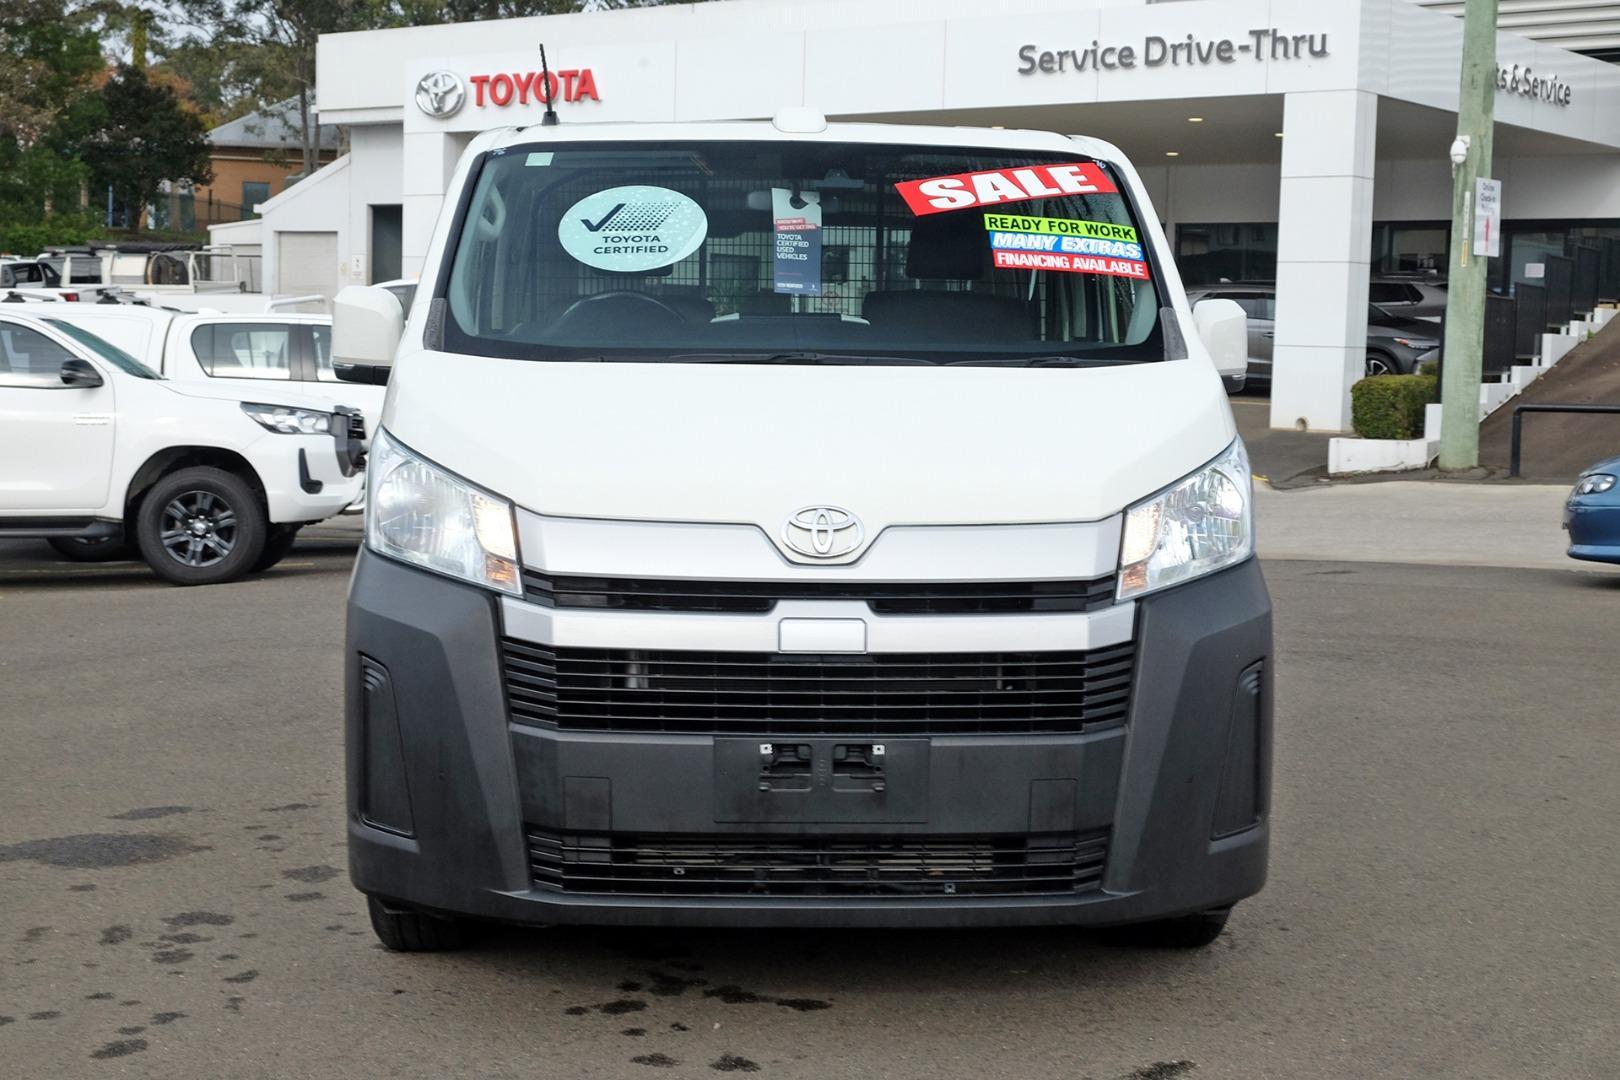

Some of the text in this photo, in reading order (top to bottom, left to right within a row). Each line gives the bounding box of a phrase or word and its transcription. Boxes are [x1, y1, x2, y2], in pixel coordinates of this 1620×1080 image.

[1017, 28, 1328, 74] Service Drive-Thru
[470, 68, 600, 107] TOYOTA
[1511, 63, 1520, 92] &
[1523, 67, 1571, 105] Service
[918, 165, 1099, 210] SALE
[602, 235, 661, 244] TOYOTA
[988, 216, 1134, 240] READY FOR WORK
[593, 245, 669, 255] CERTIFIED
[776, 240, 809, 248] CERTIFIED
[776, 252, 808, 260] VEHICLES
[992, 232, 1142, 259] MANY EXTRAS
[997, 252, 1145, 276] FINANCING AVAILABLE
